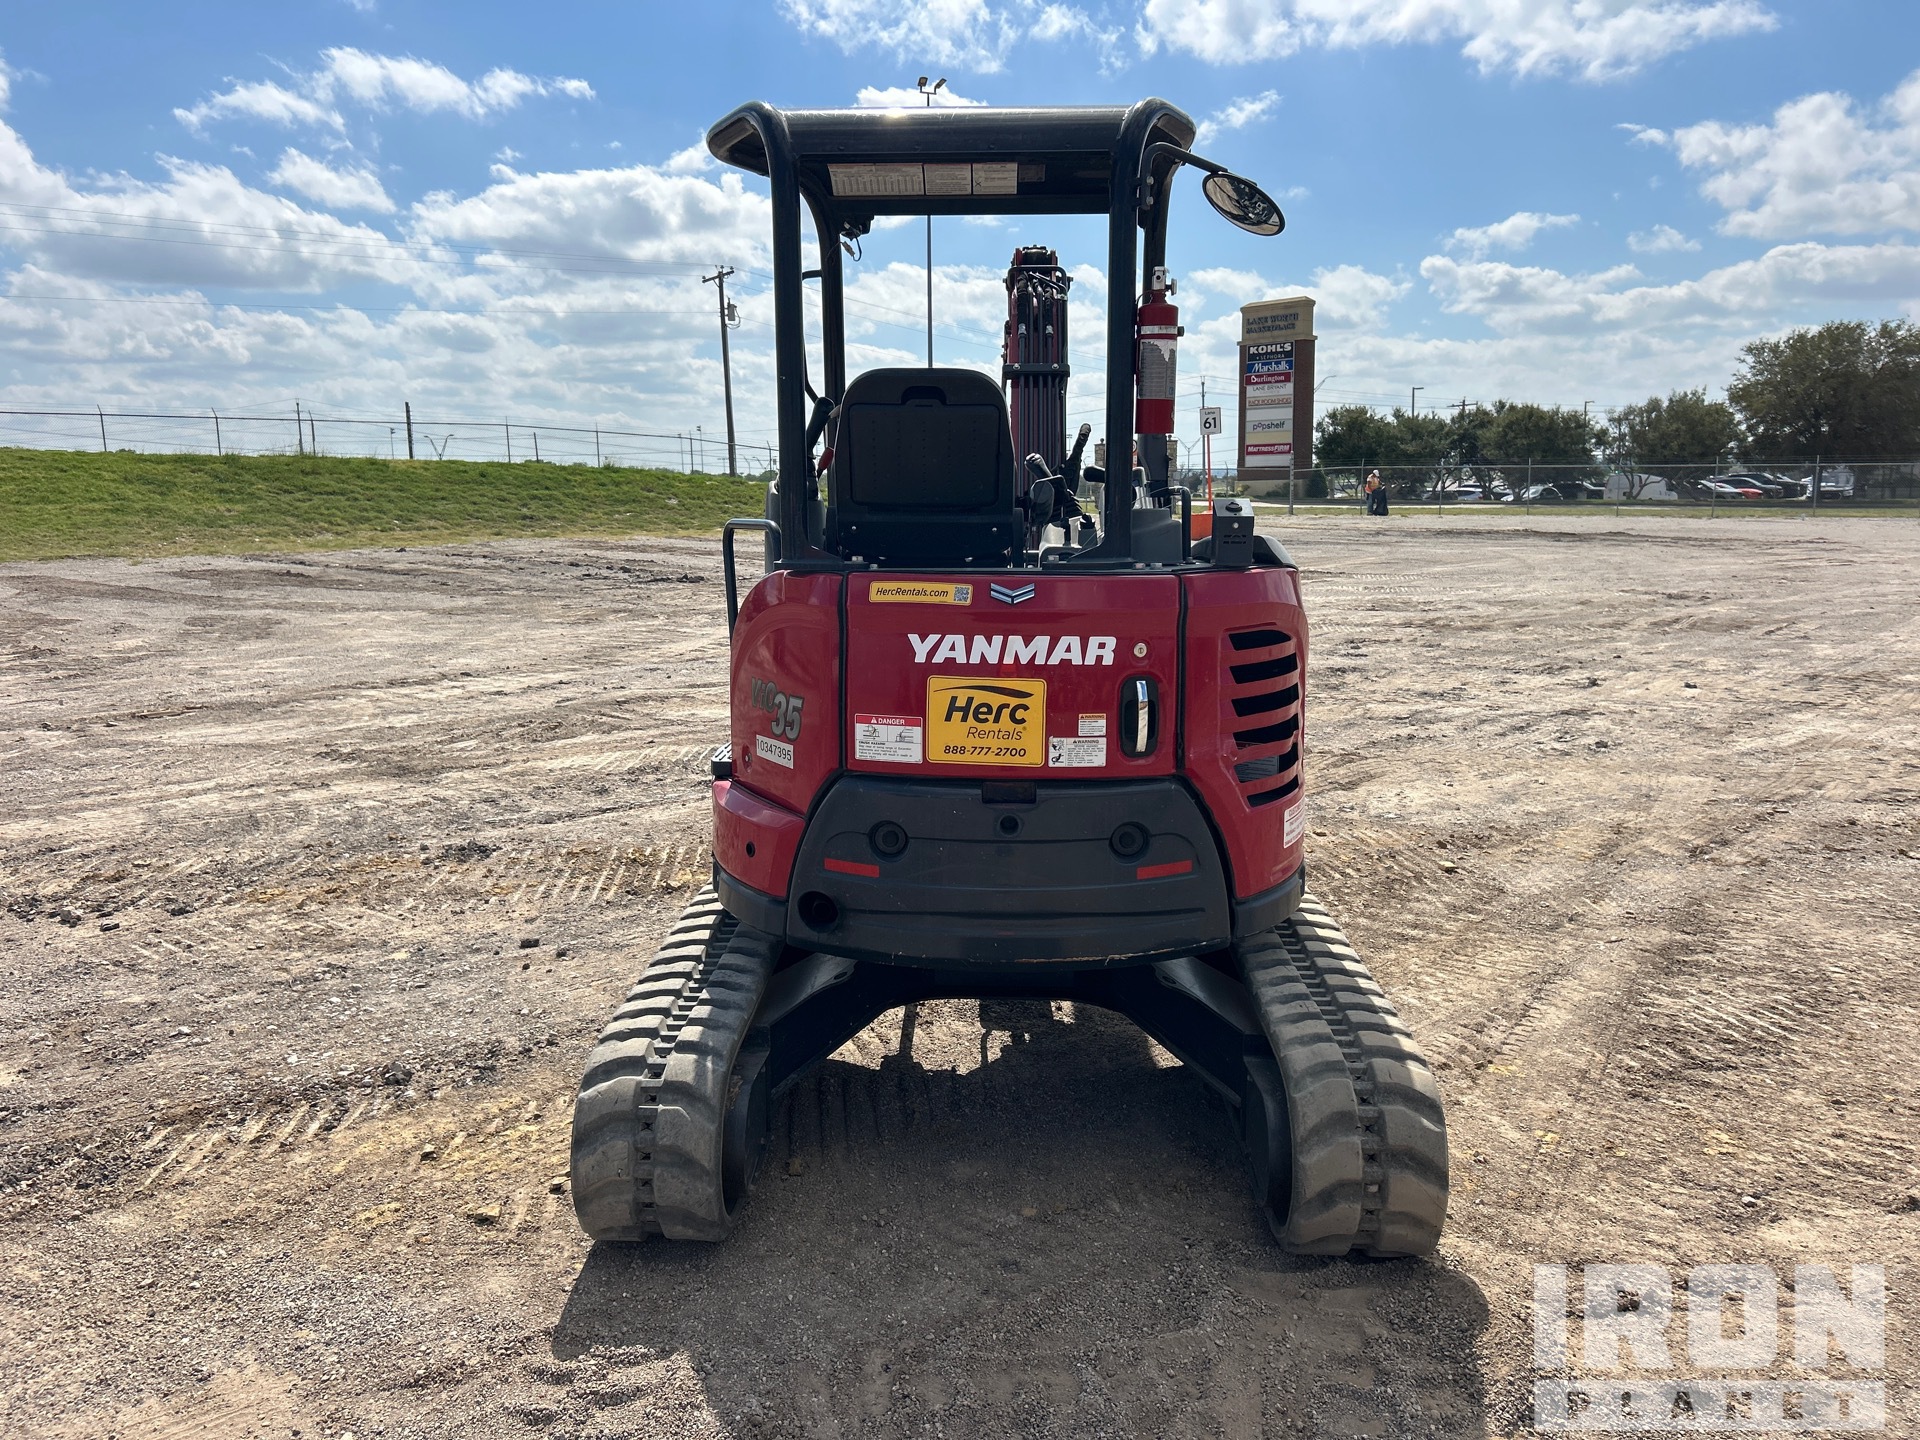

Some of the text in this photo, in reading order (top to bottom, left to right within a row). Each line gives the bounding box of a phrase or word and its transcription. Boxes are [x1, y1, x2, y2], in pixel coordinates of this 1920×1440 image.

[1250, 342, 1292, 354] KOHL'S
[1251, 360, 1290, 373] Marshalls
[1250, 374, 1285, 383] Burlington
[1203, 416, 1217, 430] 61
[1252, 421, 1286, 431] popshelf
[875, 586, 949, 598] HercRentals.com
[907, 633, 1117, 665] YANMAR
[943, 695, 1031, 725] Herc
[878, 717, 905, 725] DANGER
[966, 726, 1023, 741] Rentals
[756, 738, 793, 762] 10347395
[943, 744, 1027, 758] 888-777-2700
